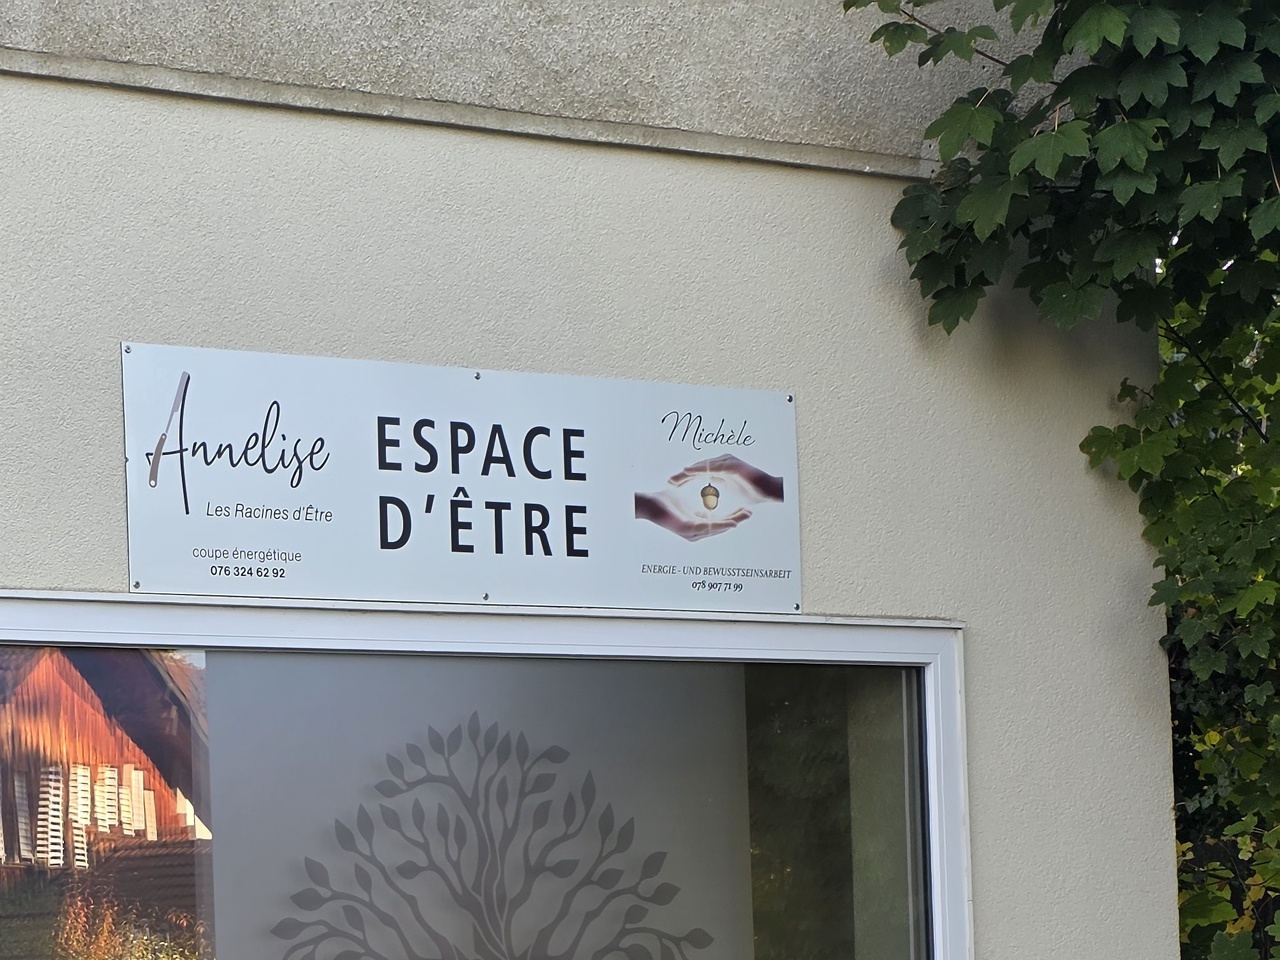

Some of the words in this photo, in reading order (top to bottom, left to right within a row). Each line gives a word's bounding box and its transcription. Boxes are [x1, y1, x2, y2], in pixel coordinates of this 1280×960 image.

[661, 410, 756, 451] Michèle
[145, 371, 330, 515] Annelise
[377, 416, 587, 481] ESPACE
[206, 501, 231, 517] Les
[234, 503, 289, 520] Racines
[292, 504, 333, 522] d'Être
[379, 486, 589, 557] D'ÊTRE
[192, 547, 230, 561] coupe
[232, 547, 302, 564] énergétique
[210, 565, 231, 576] 076
[233, 566, 253, 577] 324
[256, 567, 270, 578] 62
[272, 568, 286, 578] 92
[641, 564, 677, 575] ENERGIE
[682, 566, 702, 576] UND
[703, 567, 792, 579] BEWUSSTSEINSARBEIT
[691, 580, 706, 591] 078
[707, 582, 723, 592] 907
[723, 582, 732, 592] 71
[733, 583, 743, 592] 99
